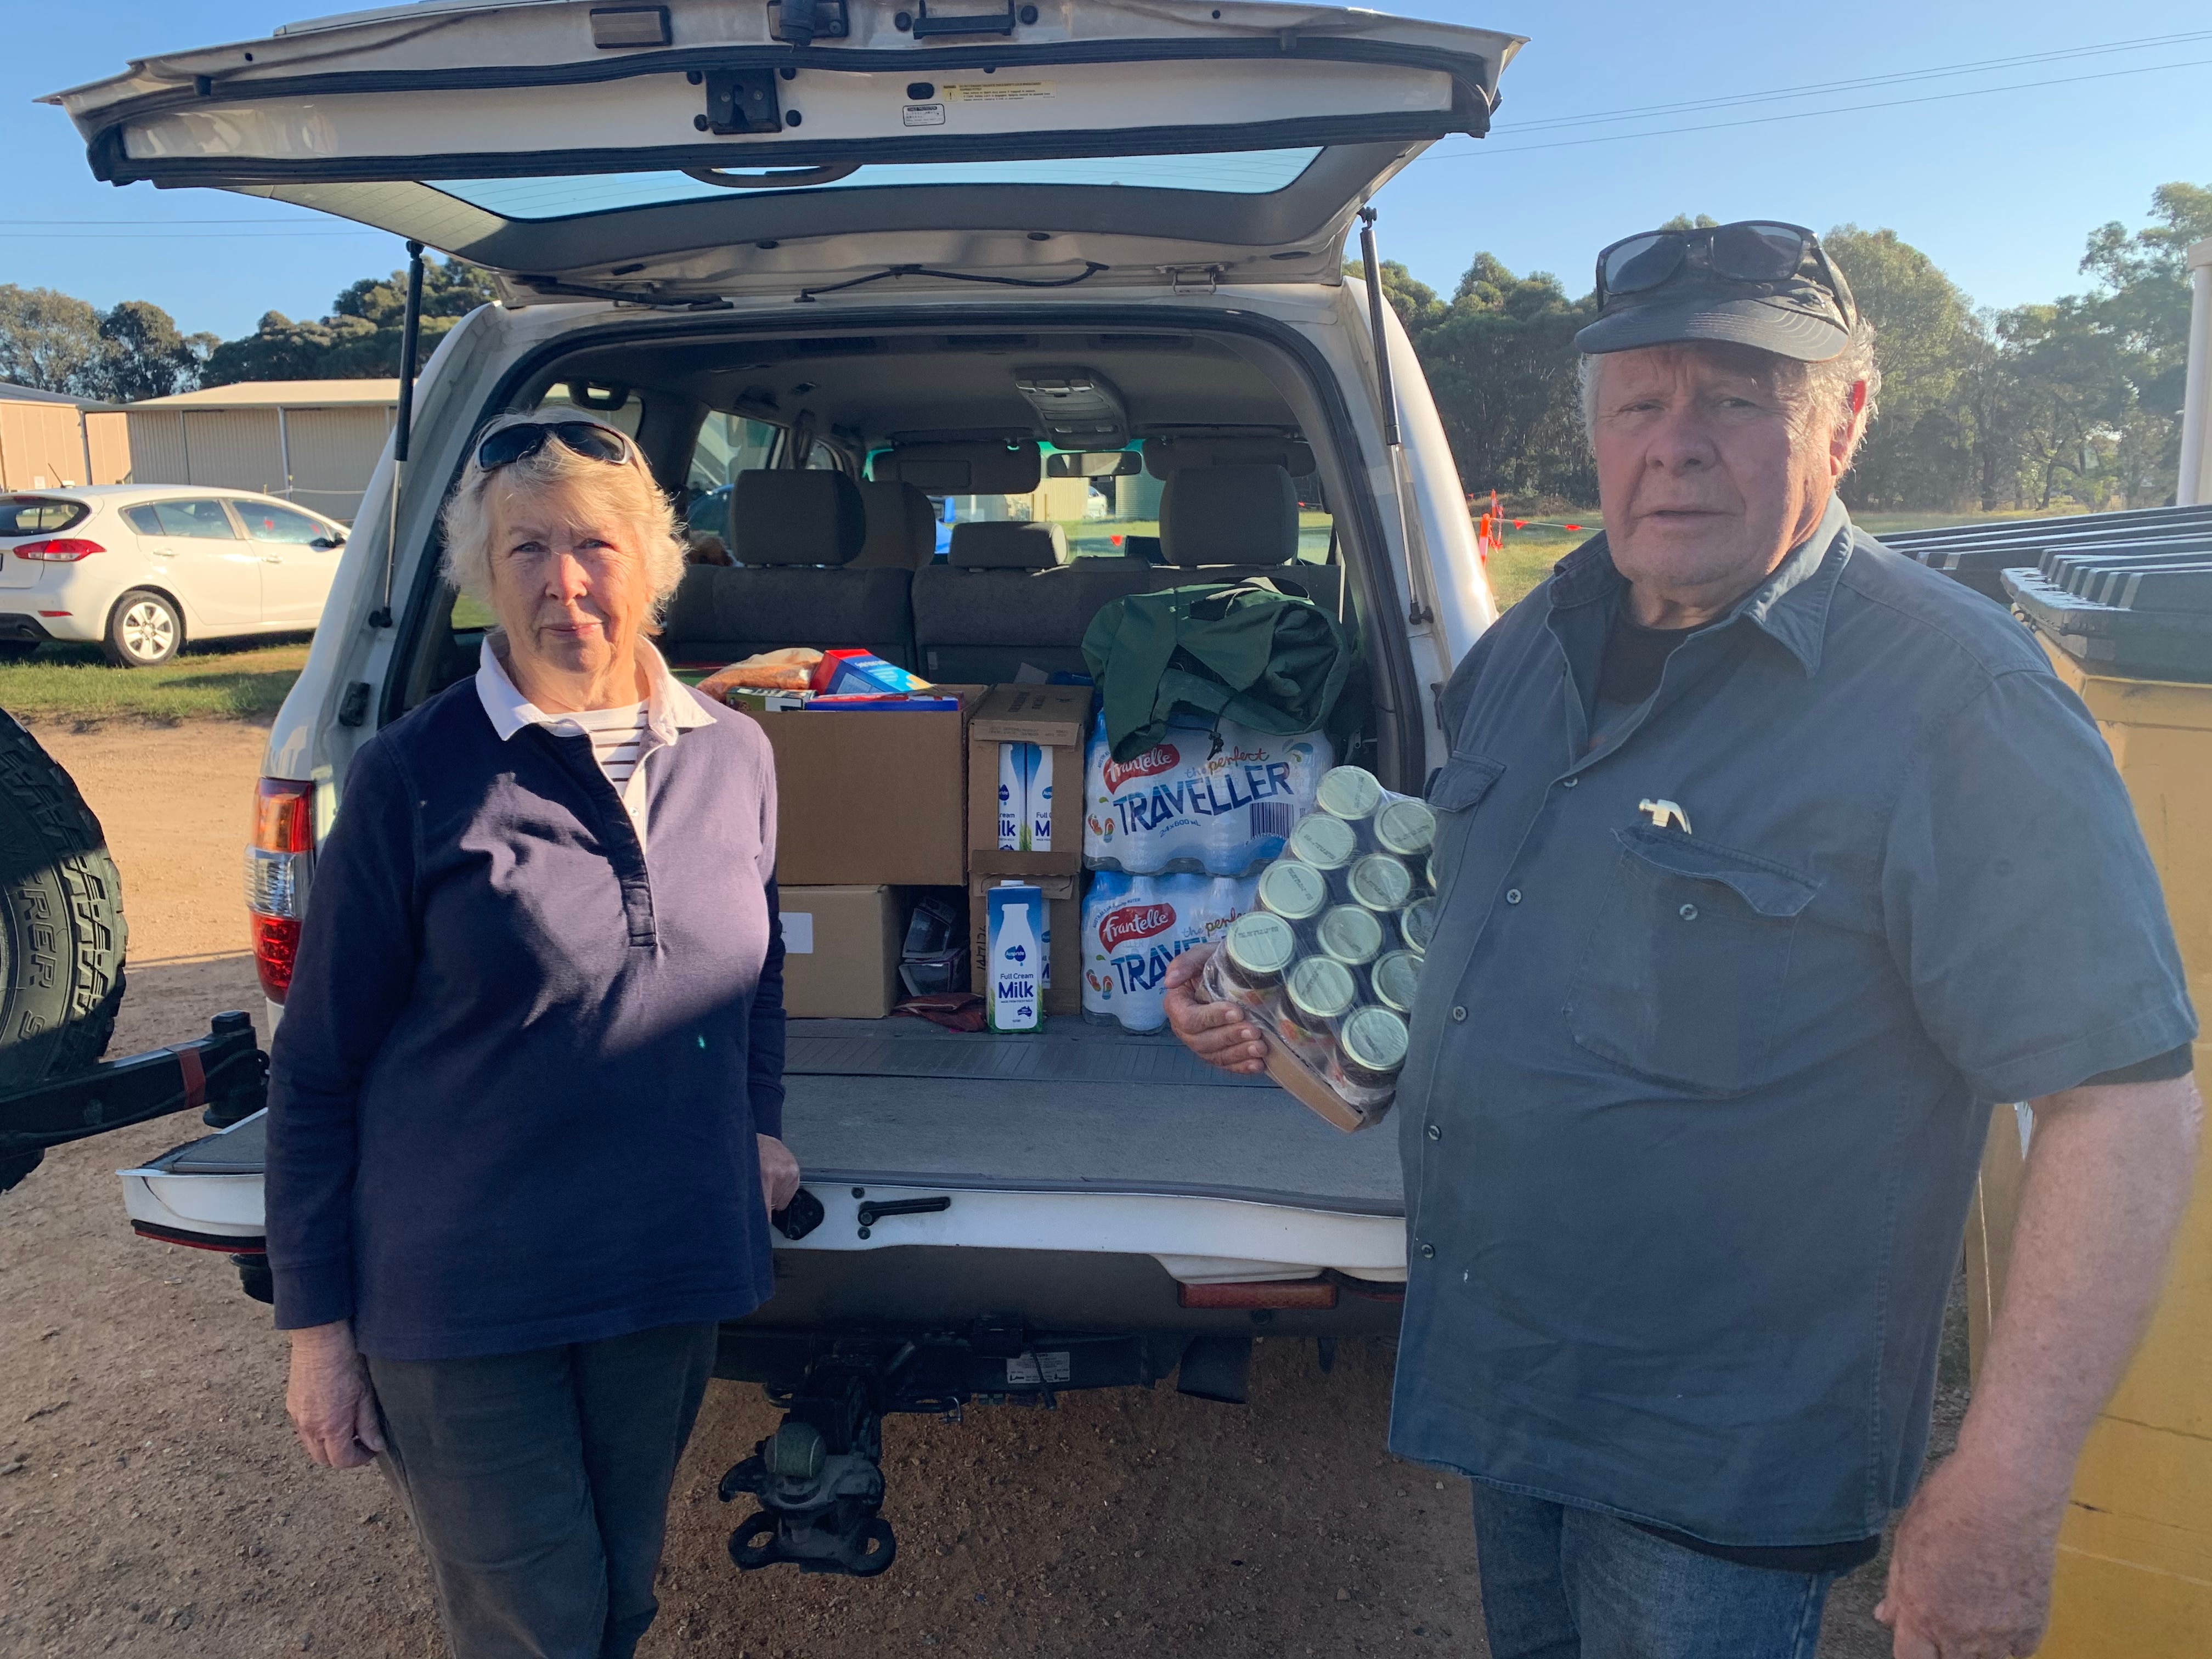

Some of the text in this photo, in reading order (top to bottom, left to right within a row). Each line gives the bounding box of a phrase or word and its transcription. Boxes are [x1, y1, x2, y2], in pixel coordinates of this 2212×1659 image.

[1097, 751, 1110, 768] AUSTRAL
[1184, 746, 1270, 778] the perfect
[1113, 761, 1295, 836] TRAVELLER
[1093, 905, 1111, 928] AUSTRALIAN
[1103, 910, 1169, 943] Frantelle
[1181, 926, 1203, 938] the
[998, 981, 1034, 998] Milk
